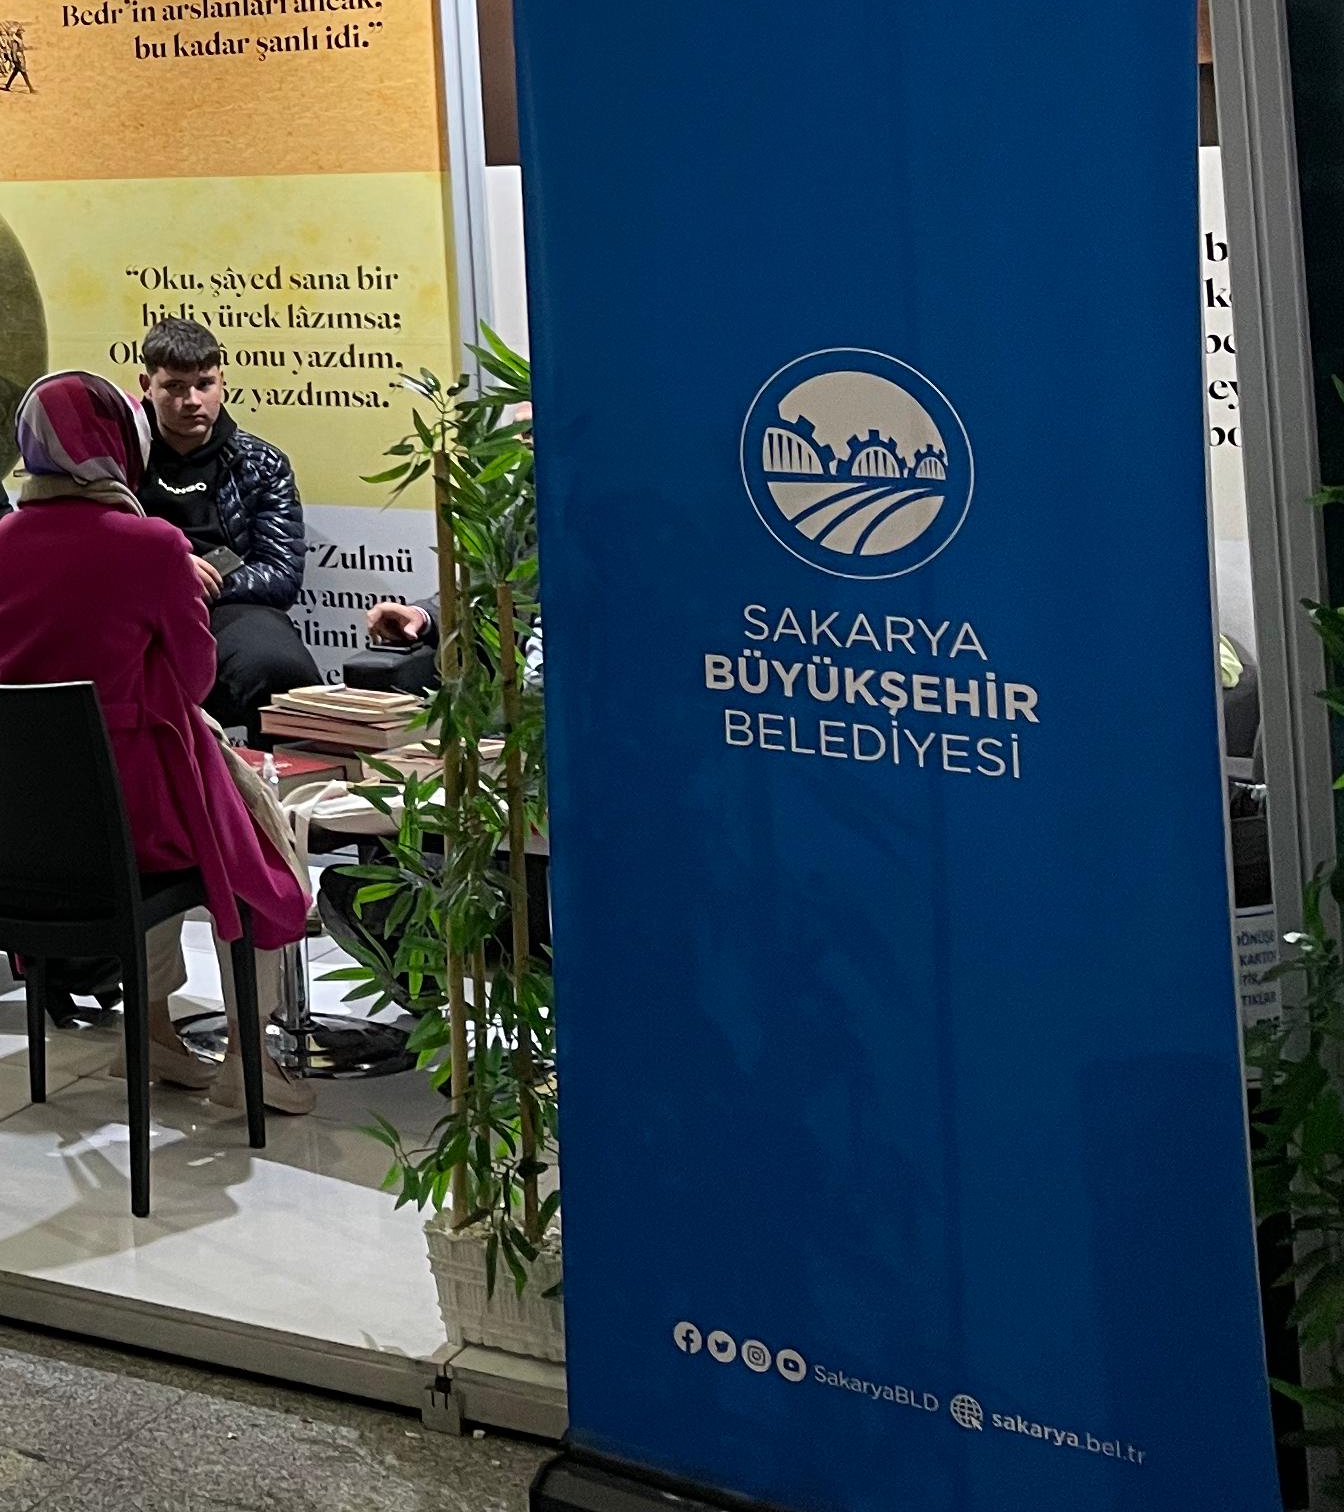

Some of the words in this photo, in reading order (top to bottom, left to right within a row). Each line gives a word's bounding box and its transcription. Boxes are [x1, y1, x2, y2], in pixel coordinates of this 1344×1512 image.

[63, 0, 157, 27] Bedr’in
[135, 35, 167, 60] bu
[174, 31, 250, 58] kadar
[256, 26, 318, 62] şanlı
[125, 265, 205, 295] “Oku,
[210, 265, 282, 298] şâyed
[289, 272, 351, 290] sana
[357, 264, 399, 290] bir
[202, 303, 282, 329] yürek
[287, 303, 402, 335] lâzımsa;
[236, 349, 286, 367] onu
[742, 603, 988, 661] SAKARYA
[704, 647, 1041, 724] BÜYÜKŞEHİR
[724, 708, 1021, 780] BELEDİYESİ
[813, 1364, 940, 1413] SakaryaBLD
[991, 1410, 1146, 1466] sakarya.bel.tr
